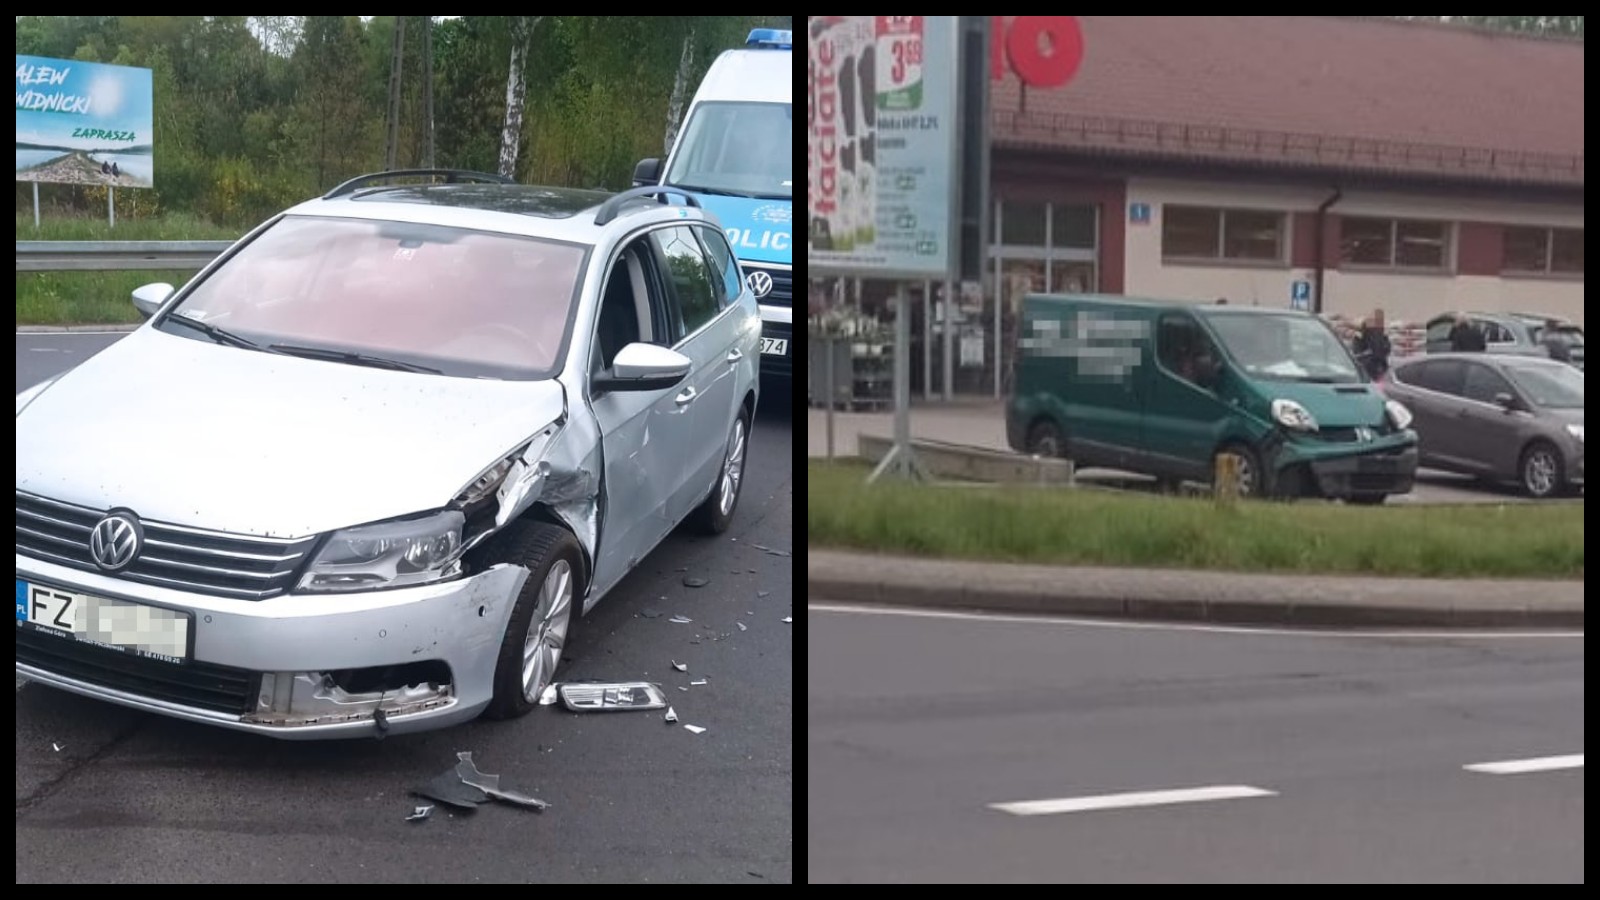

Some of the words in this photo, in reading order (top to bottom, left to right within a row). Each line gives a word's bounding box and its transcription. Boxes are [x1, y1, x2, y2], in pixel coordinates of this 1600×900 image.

[72, 127, 136, 142] ZAPRASZA
[16, 603, 26, 614] PL
[32, 588, 73, 629] FZ
